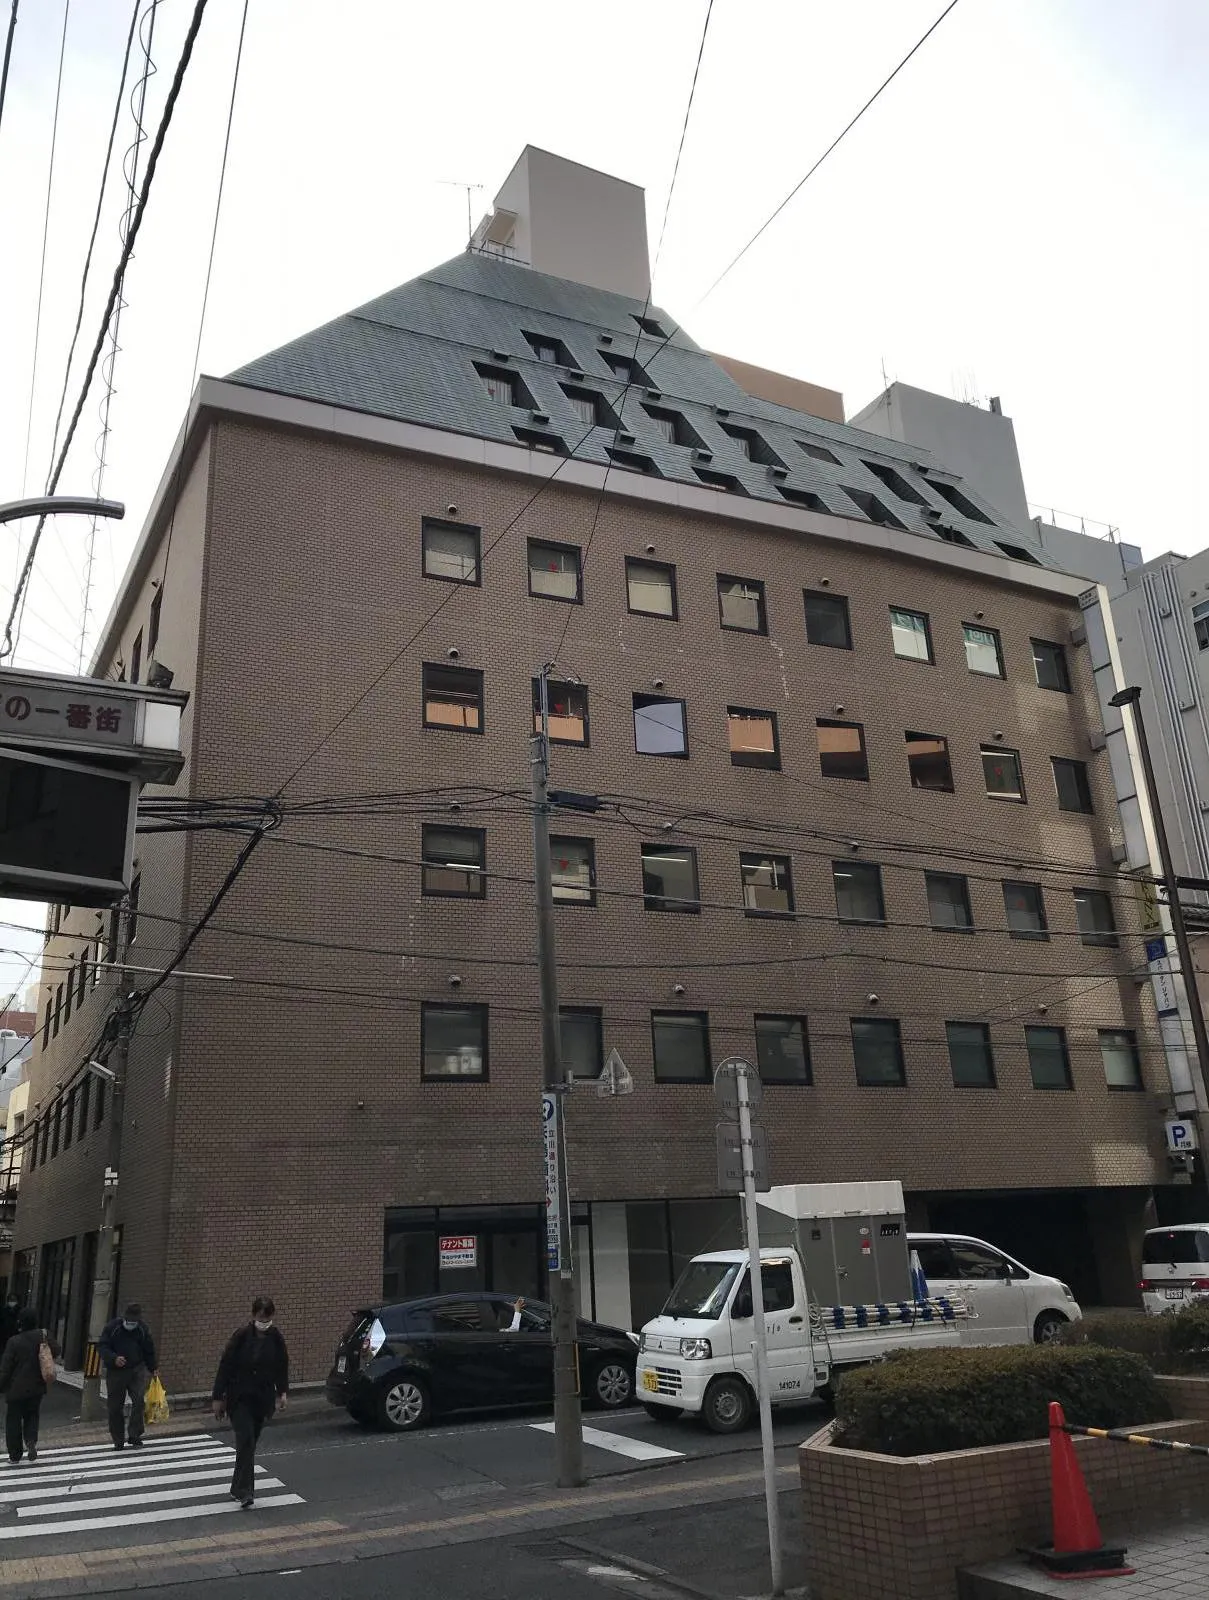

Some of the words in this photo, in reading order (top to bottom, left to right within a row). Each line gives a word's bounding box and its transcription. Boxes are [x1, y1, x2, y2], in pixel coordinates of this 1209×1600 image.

[0, 694, 121, 734] の一番街
[1172, 1125, 1186, 1147] P
